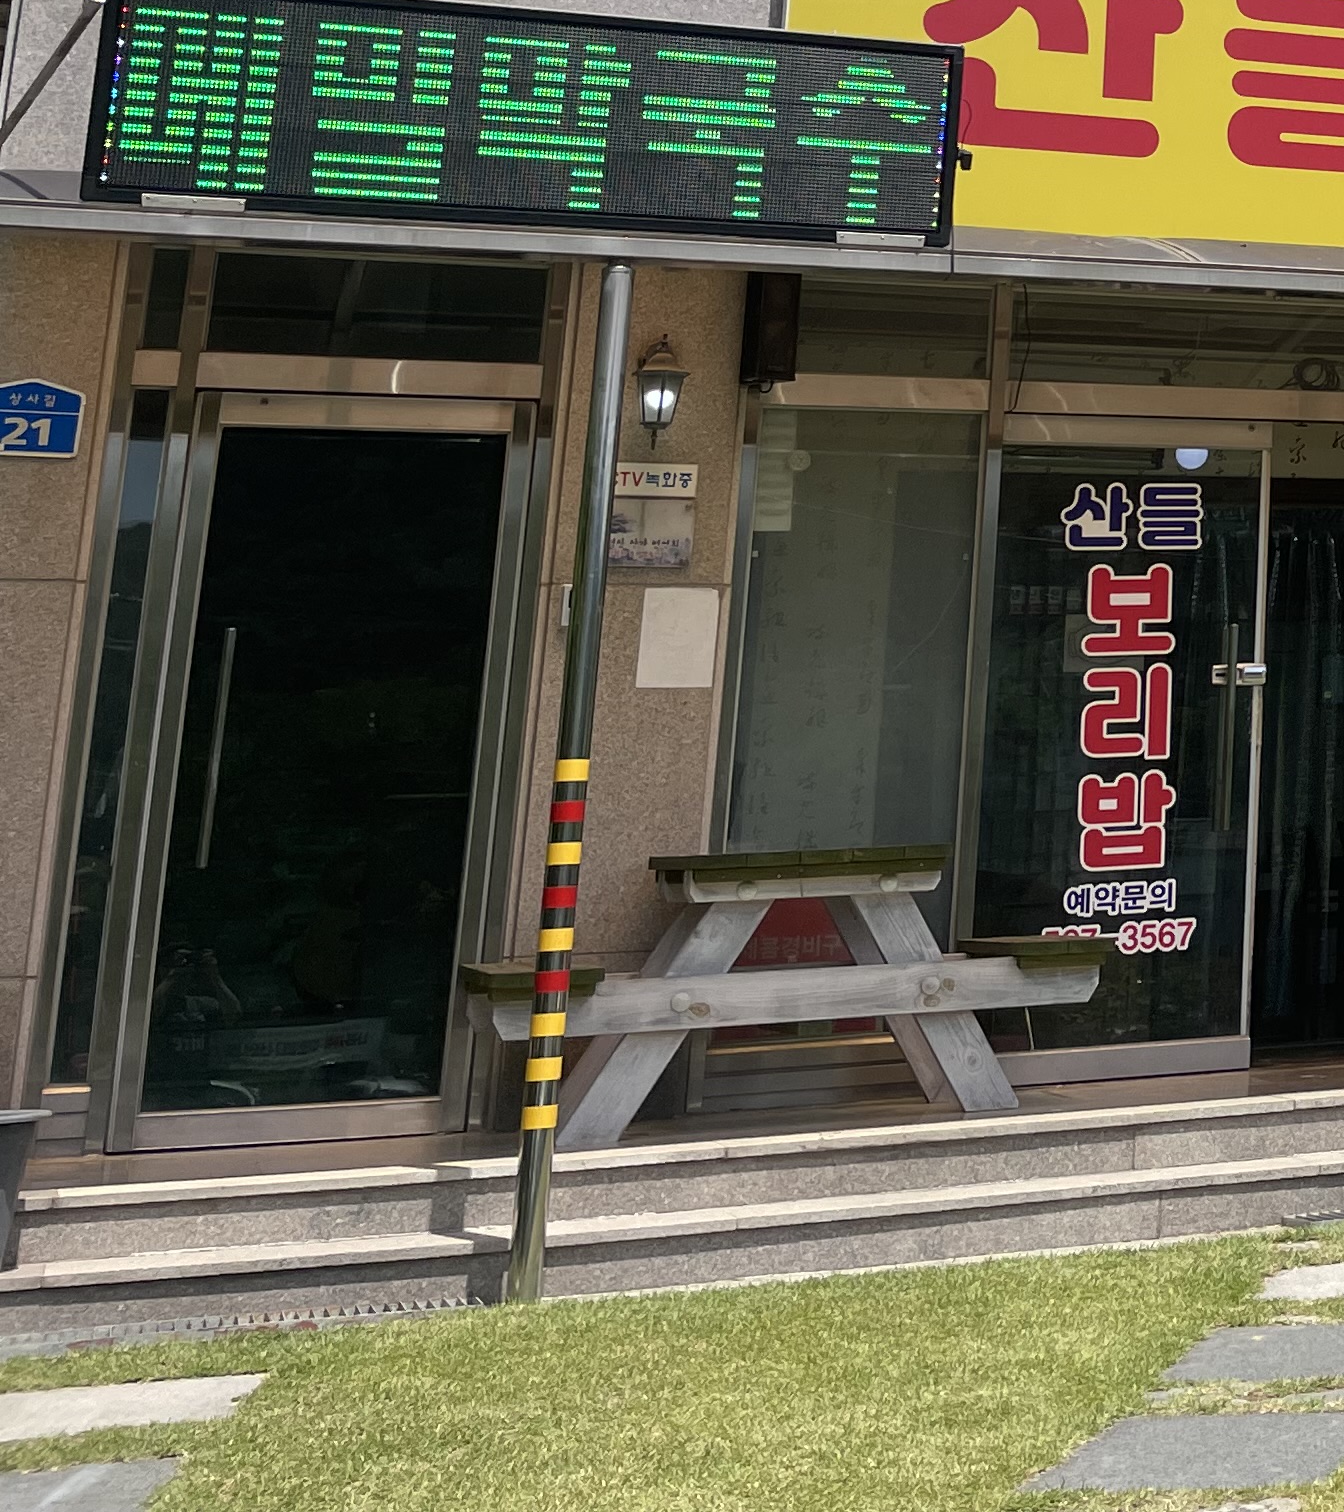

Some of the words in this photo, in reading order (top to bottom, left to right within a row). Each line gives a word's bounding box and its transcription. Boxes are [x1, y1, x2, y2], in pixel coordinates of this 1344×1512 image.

[119, 6, 932, 225] 메밀막국수
[1, 416, 52, 447] 21
[615, 472, 693, 489] TV녹화중
[1061, 483, 1203, 551] 산들
[1077, 563, 1176, 873] 보리밥
[1064, 879, 1176, 917] 예약문의
